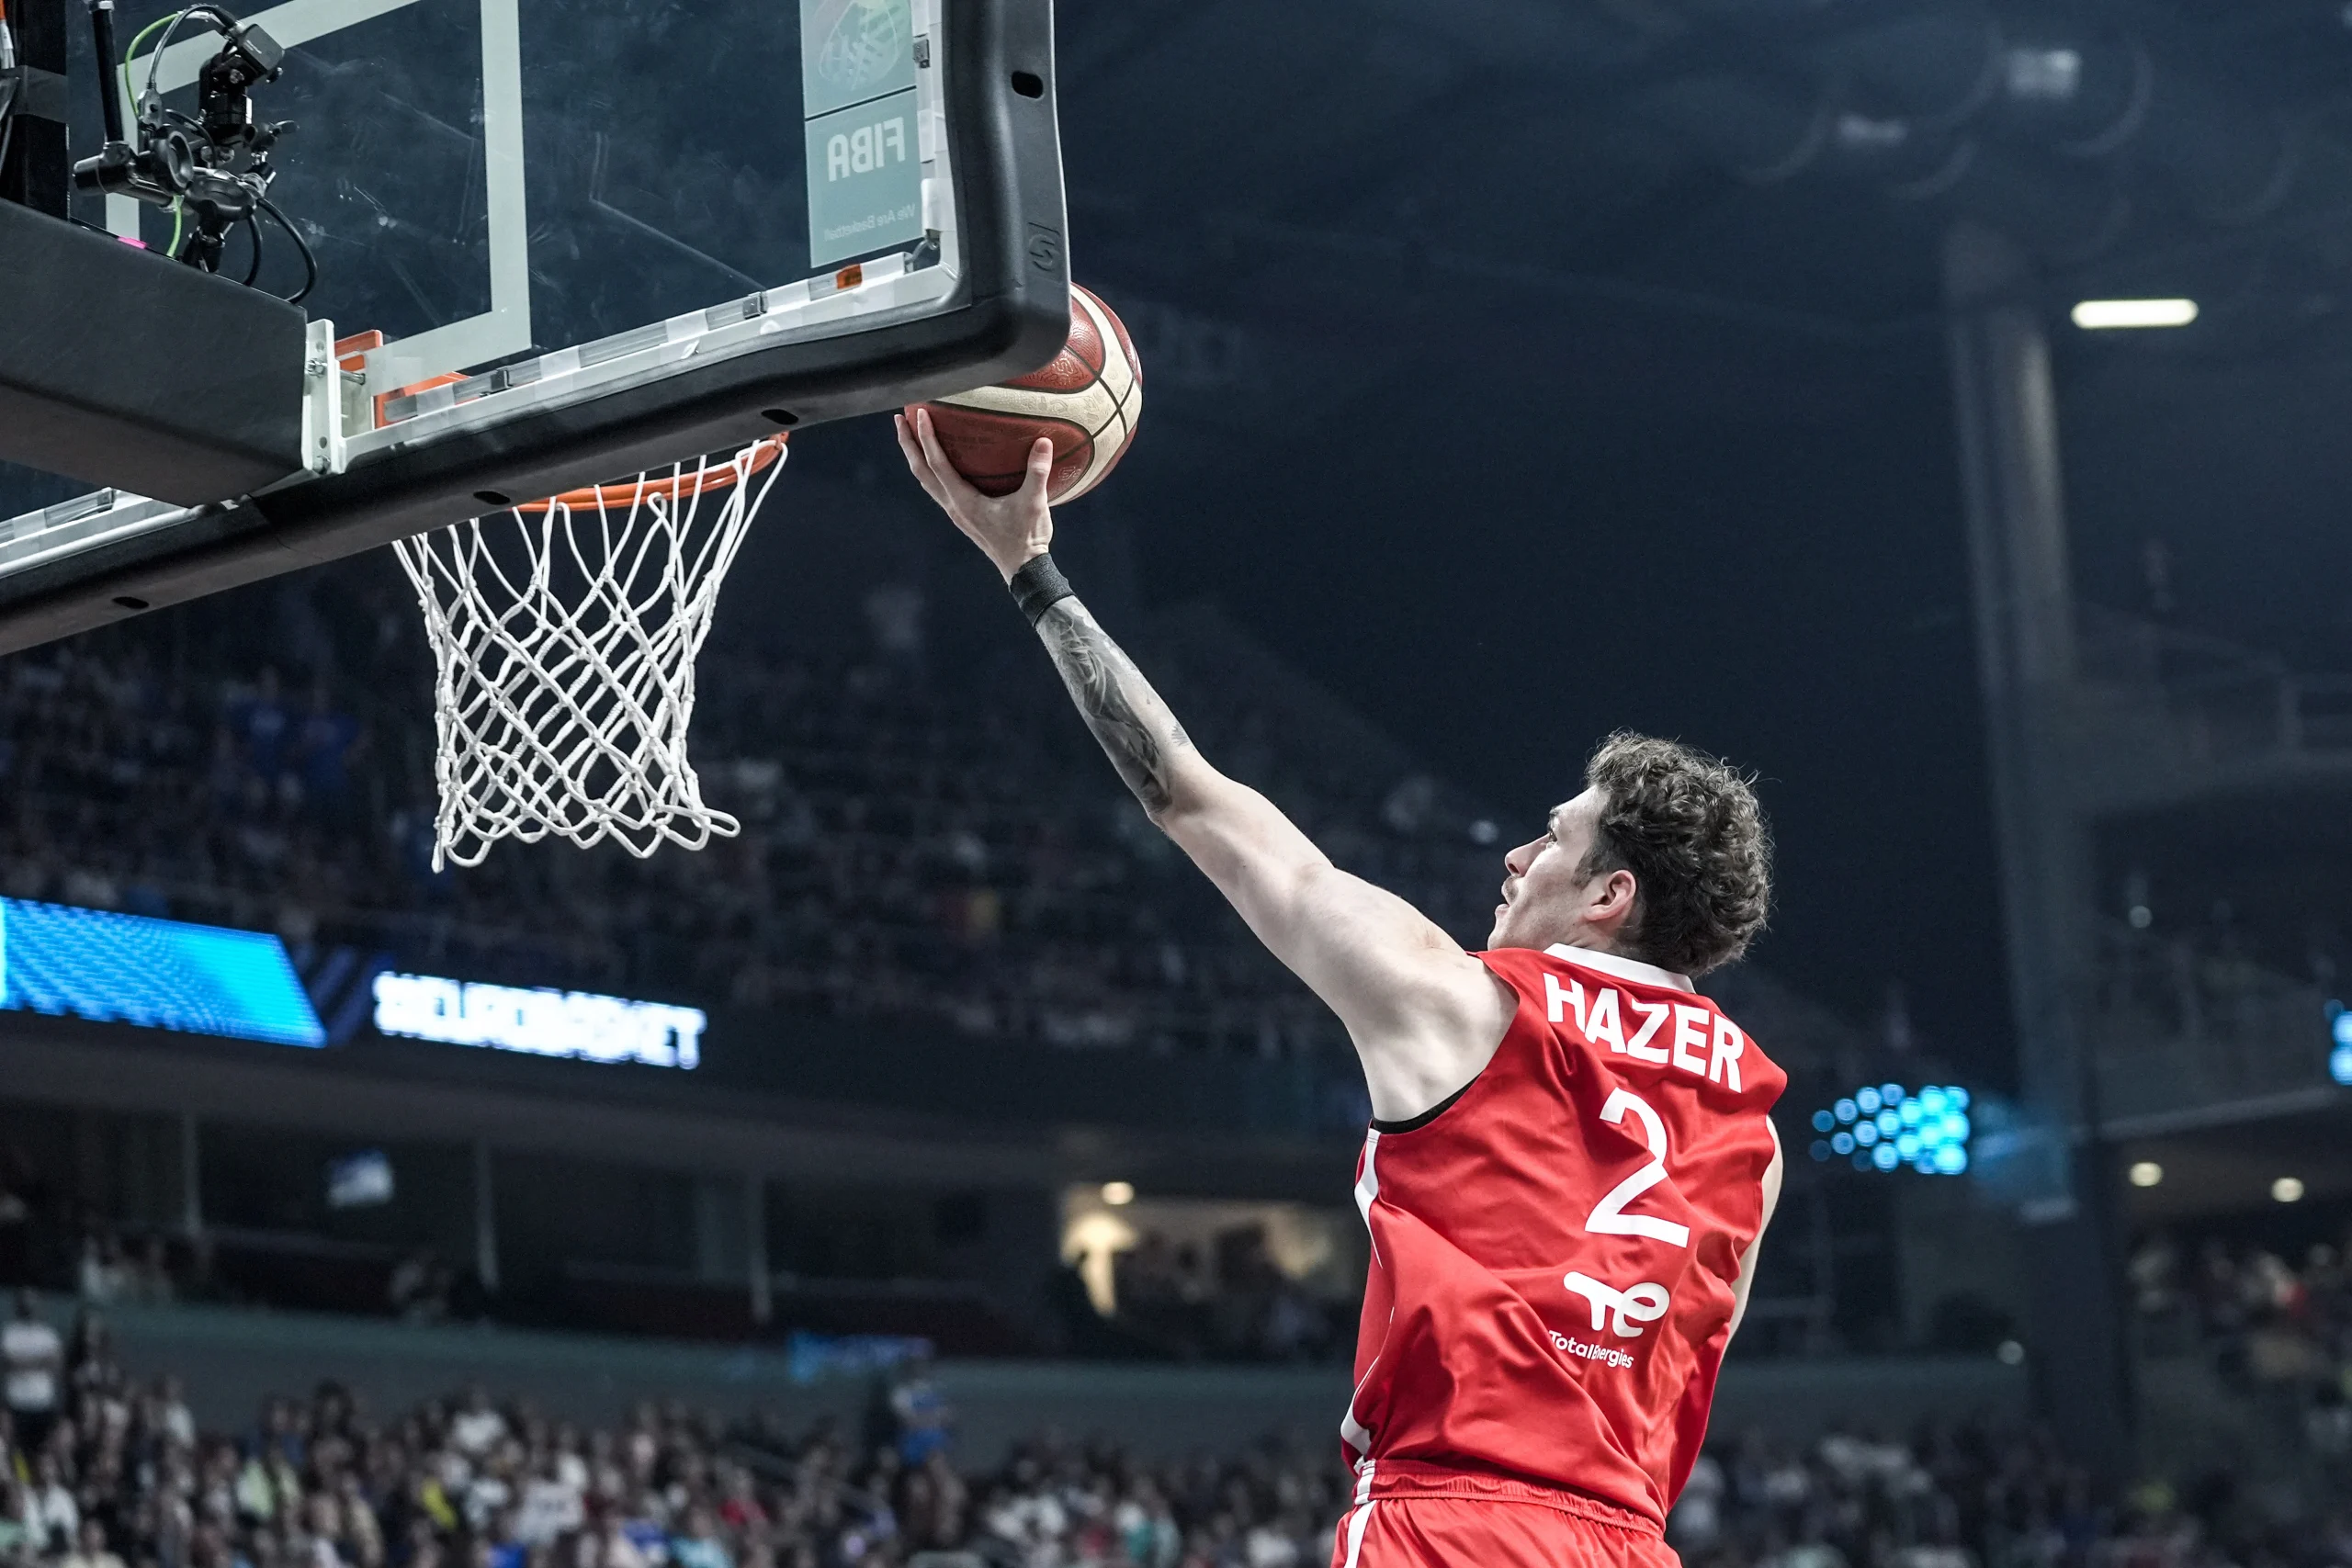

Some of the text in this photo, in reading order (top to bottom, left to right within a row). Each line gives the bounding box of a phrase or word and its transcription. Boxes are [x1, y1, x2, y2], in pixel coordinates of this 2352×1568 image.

[1543, 973, 1745, 1093] HAZER
[1585, 1087, 1690, 1248] 2
[1548, 1330, 1634, 1369] TotalEnergies
